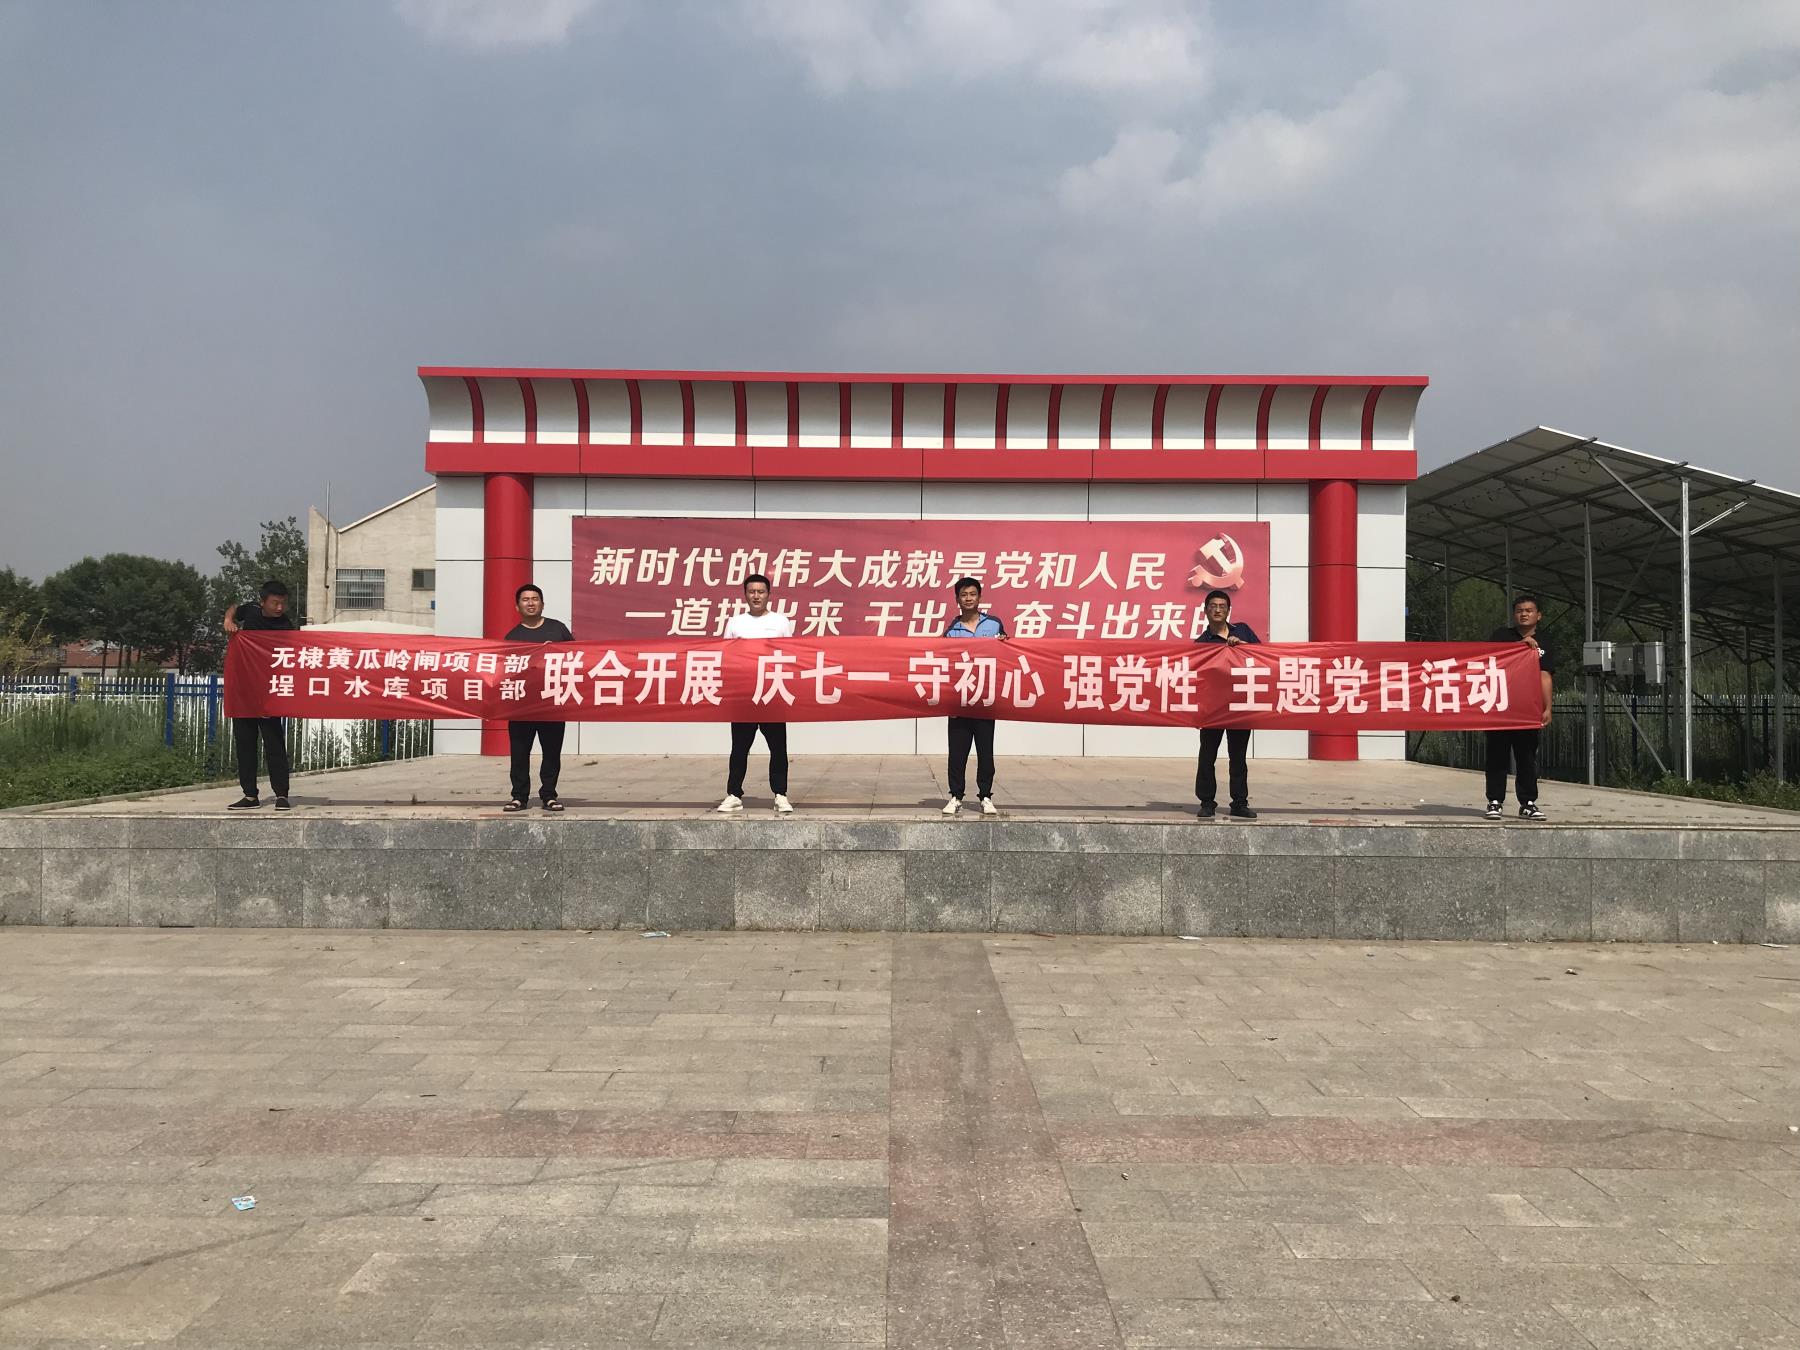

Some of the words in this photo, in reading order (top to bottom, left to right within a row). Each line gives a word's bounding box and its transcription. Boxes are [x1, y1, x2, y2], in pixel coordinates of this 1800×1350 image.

[590, 547, 1166, 590] 新时代的伟大成就是党和人民
[864, 600, 992, 638] 干出
[270, 647, 531, 674] 无棣黄瓜岭闸项目部
[269, 674, 526, 701] 埕口水库项目部
[541, 650, 724, 706] 联合开展
[752, 650, 890, 706] 庆七一
[907, 651, 1045, 708] 守初心
[1063, 654, 1199, 713] 强党性
[1229, 656, 1509, 714] 主题党日活动
